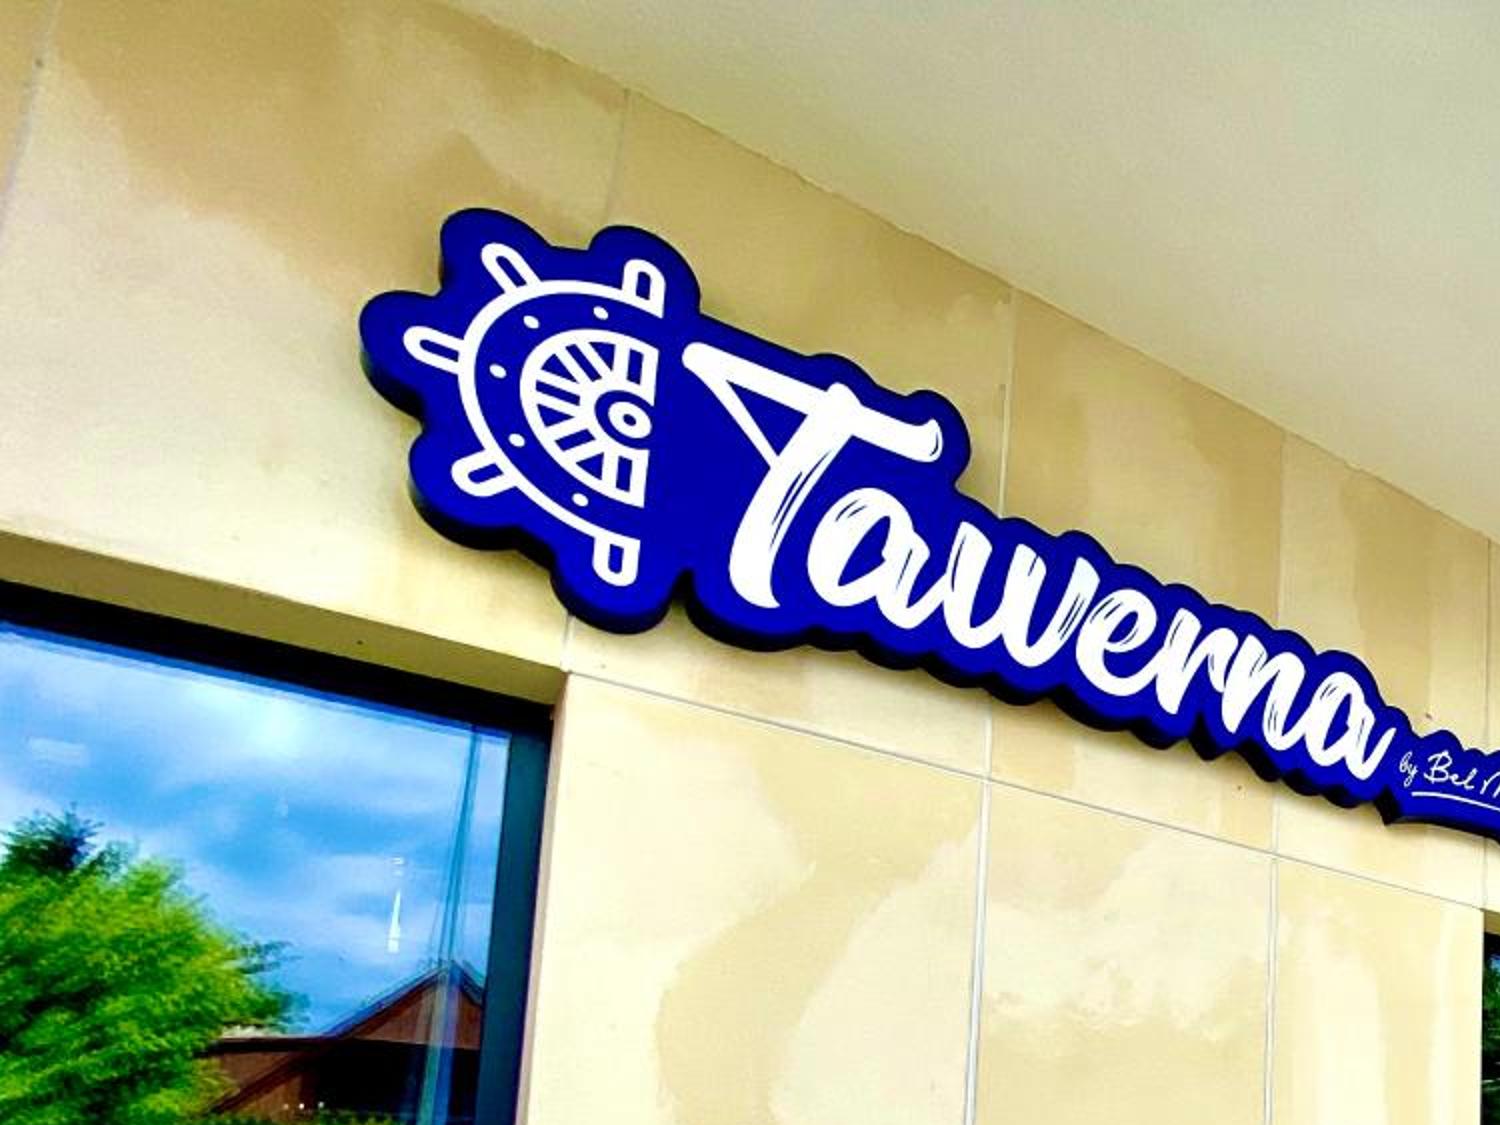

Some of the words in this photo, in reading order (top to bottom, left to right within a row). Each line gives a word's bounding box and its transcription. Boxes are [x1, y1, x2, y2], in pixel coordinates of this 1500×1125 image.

[682, 343, 1397, 780] Tawerna
[1400, 751, 1418, 787] by
[1424, 750, 1477, 790] Bel
